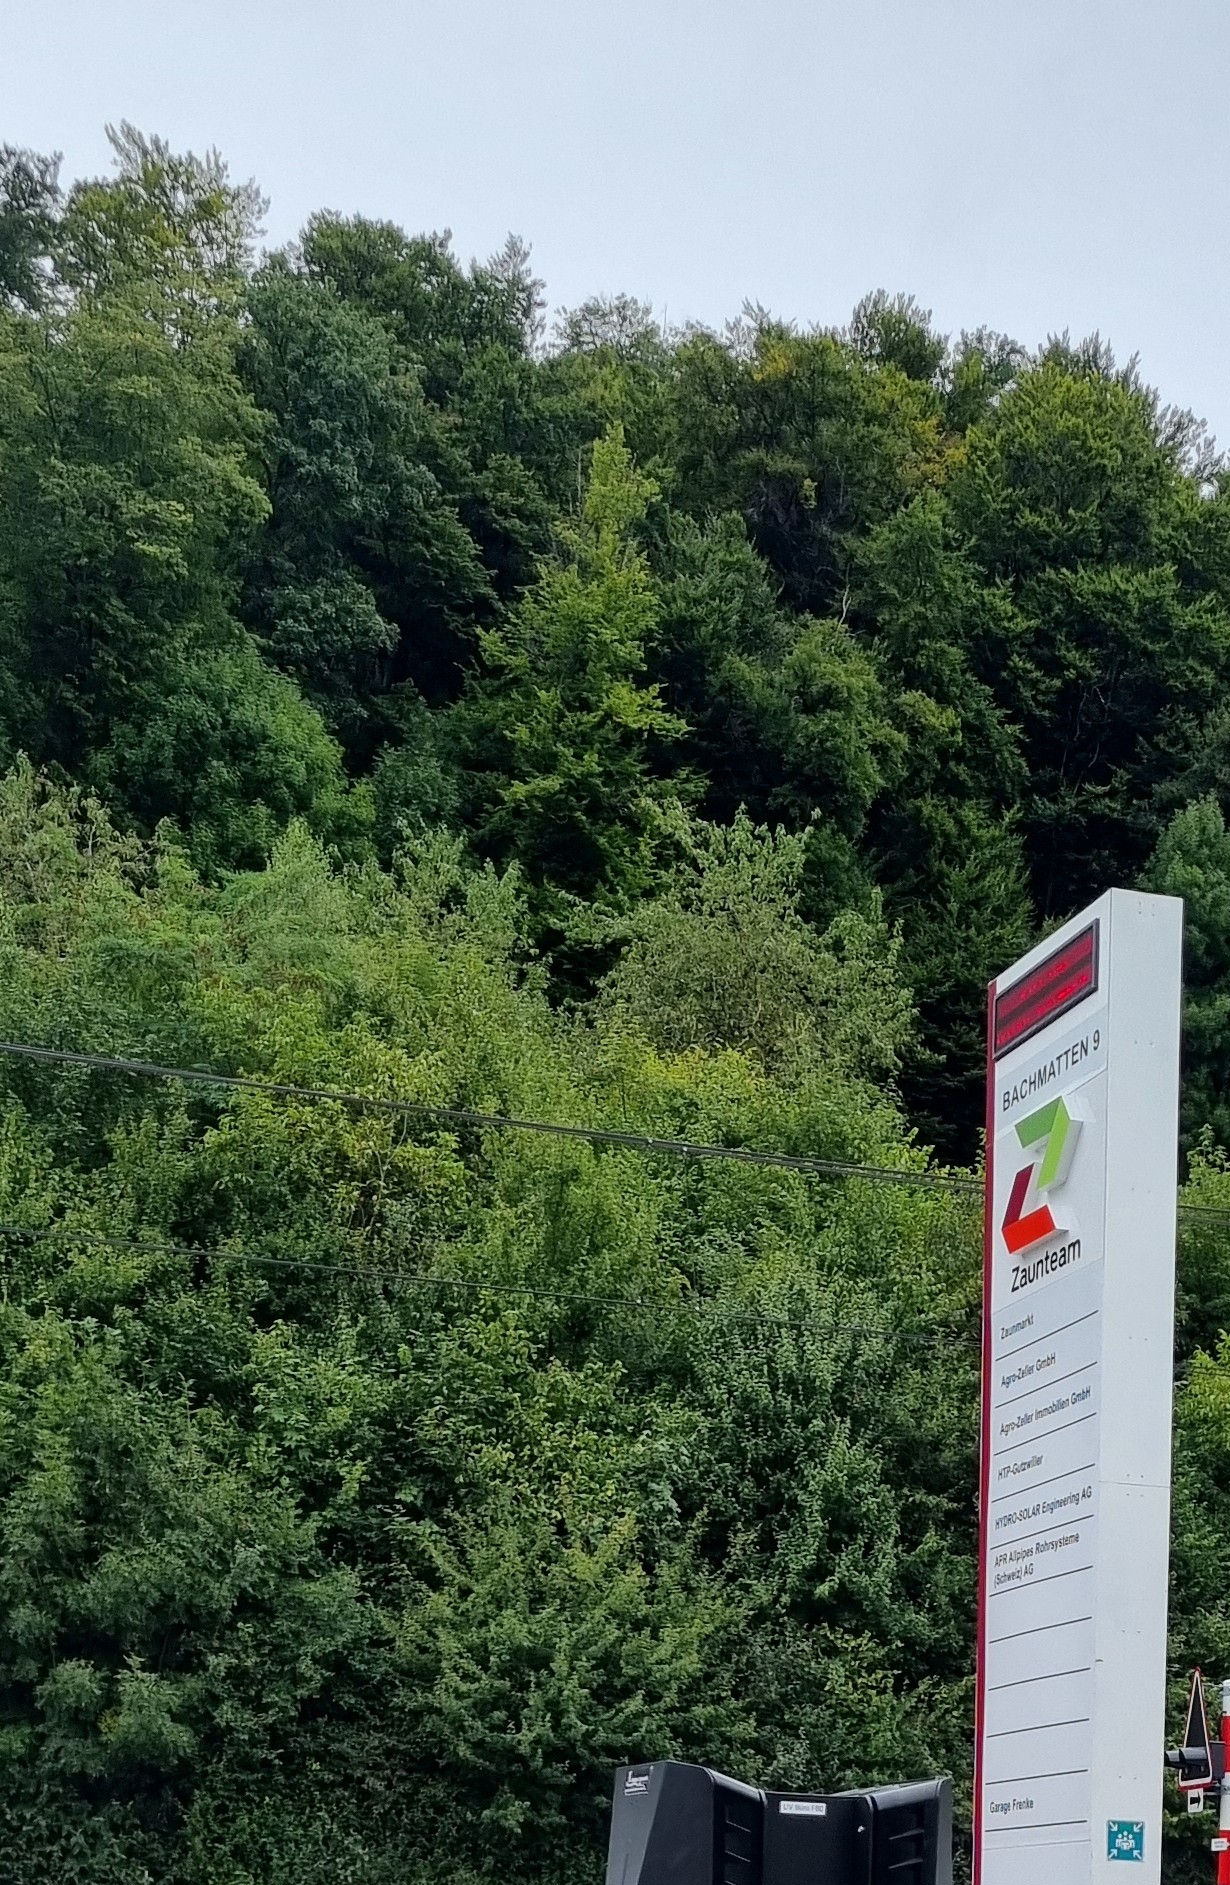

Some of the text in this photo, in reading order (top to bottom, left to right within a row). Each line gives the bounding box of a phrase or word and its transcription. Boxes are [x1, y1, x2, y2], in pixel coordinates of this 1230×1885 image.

[1002, 1028, 1101, 1112] BACHMATTEN 9
[1010, 1238, 1082, 1293] Zaunteam
[1000, 1313, 1034, 1340] Zaunmarkt
[1000, 1352, 1057, 1389] Agro-Zeller GmbH
[1034, 1397, 1070, 1421] Immobilien
[1070, 1385, 1091, 1405] GmbH
[994, 1485, 1093, 1530] HYDRO-SOLAR Engineering AG
[1034, 1532, 1080, 1553] Rohrsysteme
[1023, 1562, 1034, 1577] AG
[989, 1797, 1034, 1815] Garage Frenke
